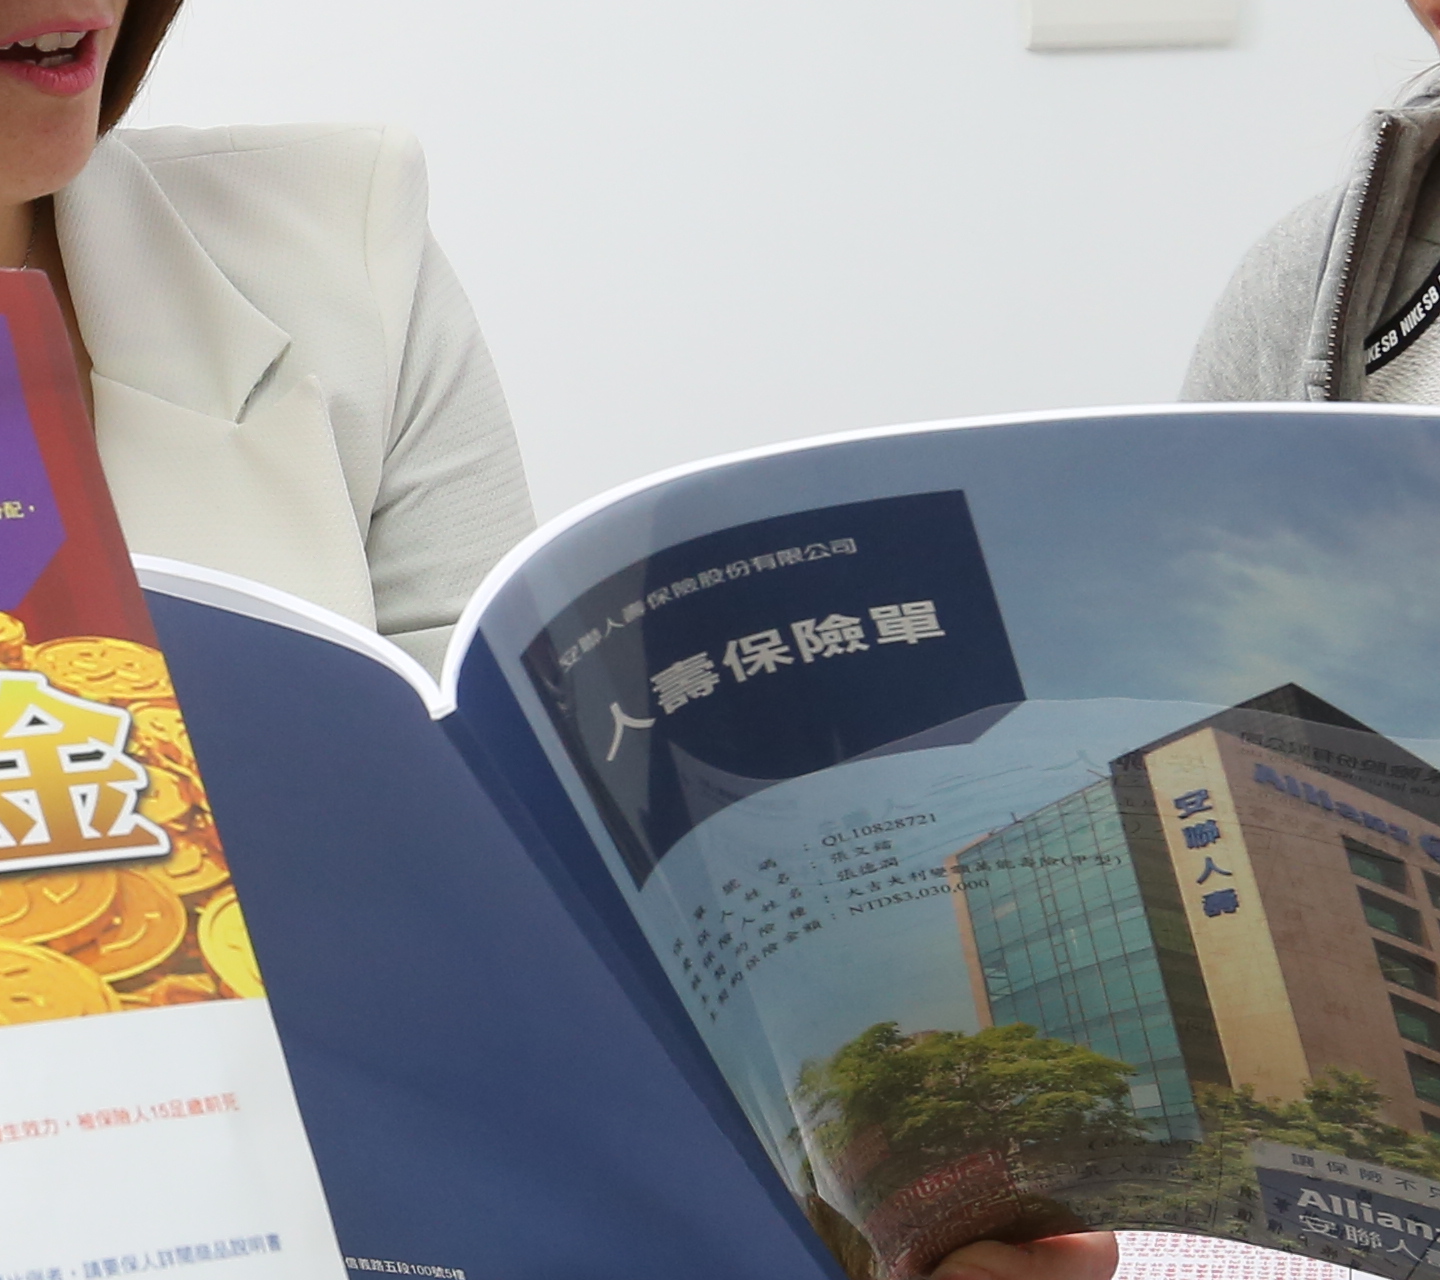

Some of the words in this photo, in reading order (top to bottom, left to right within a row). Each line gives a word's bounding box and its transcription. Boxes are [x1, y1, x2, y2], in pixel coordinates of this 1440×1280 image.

[1380, 328, 1400, 353] SB
[1398, 302, 1425, 337] NIKE
[1420, 286, 1440, 311] SB
[556, 535, 858, 674] 安聯人壽保險股份有限公司
[605, 598, 947, 763] 人壽保險單
[821, 812, 938, 848] QL10828721
[1171, 787, 1241, 918] 安聯人壽
